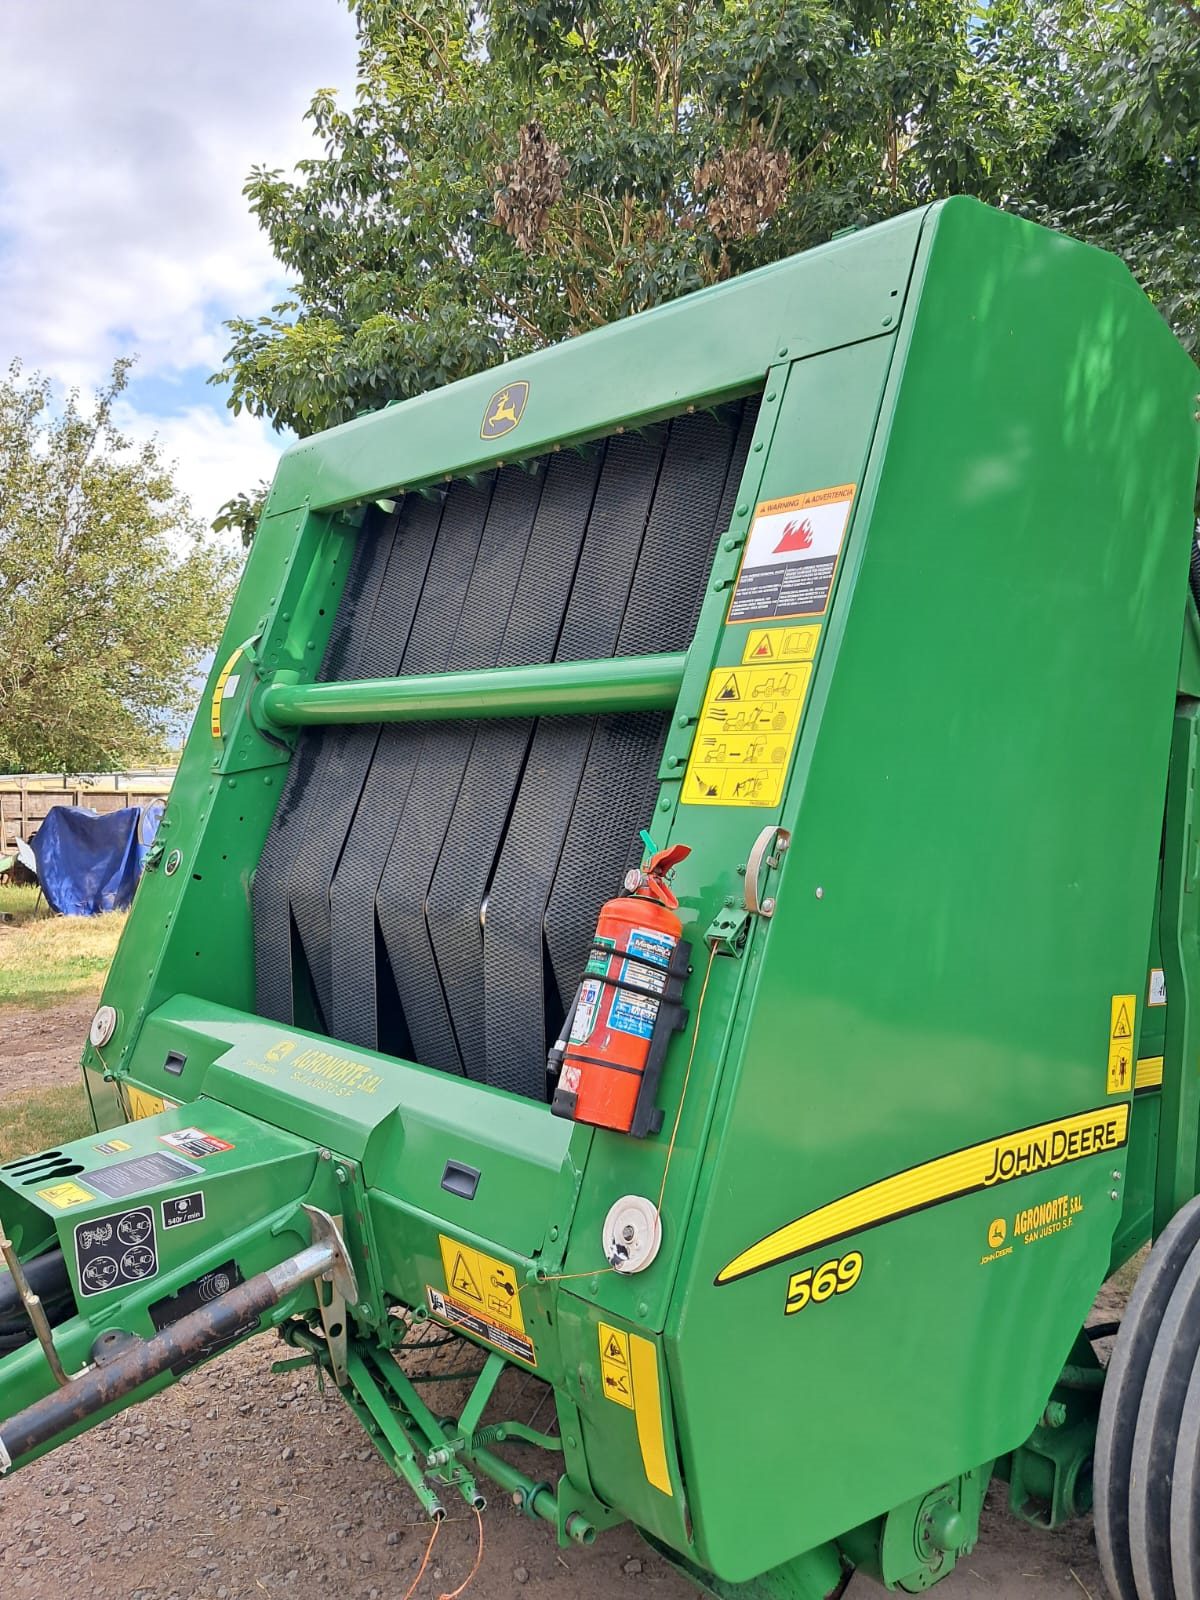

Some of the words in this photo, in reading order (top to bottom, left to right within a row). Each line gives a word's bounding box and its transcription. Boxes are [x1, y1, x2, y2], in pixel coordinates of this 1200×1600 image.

[768, 500, 799, 511] WARNING
[811, 488, 853, 502] ADVERTENCIA
[290, 1049, 371, 1087] AGRONORTE
[984, 1140, 1047, 1181] JOHN
[1051, 1121, 1117, 1161] DEERE
[1013, 1195, 1068, 1236] AGRONORTE
[1024, 1231, 1038, 1245] SAN
[1039, 1222, 1061, 1239] JUSTO
[980, 1253, 996, 1265] JOHN
[995, 1246, 1013, 1259] DEERE
[784, 1250, 863, 1316] 569
